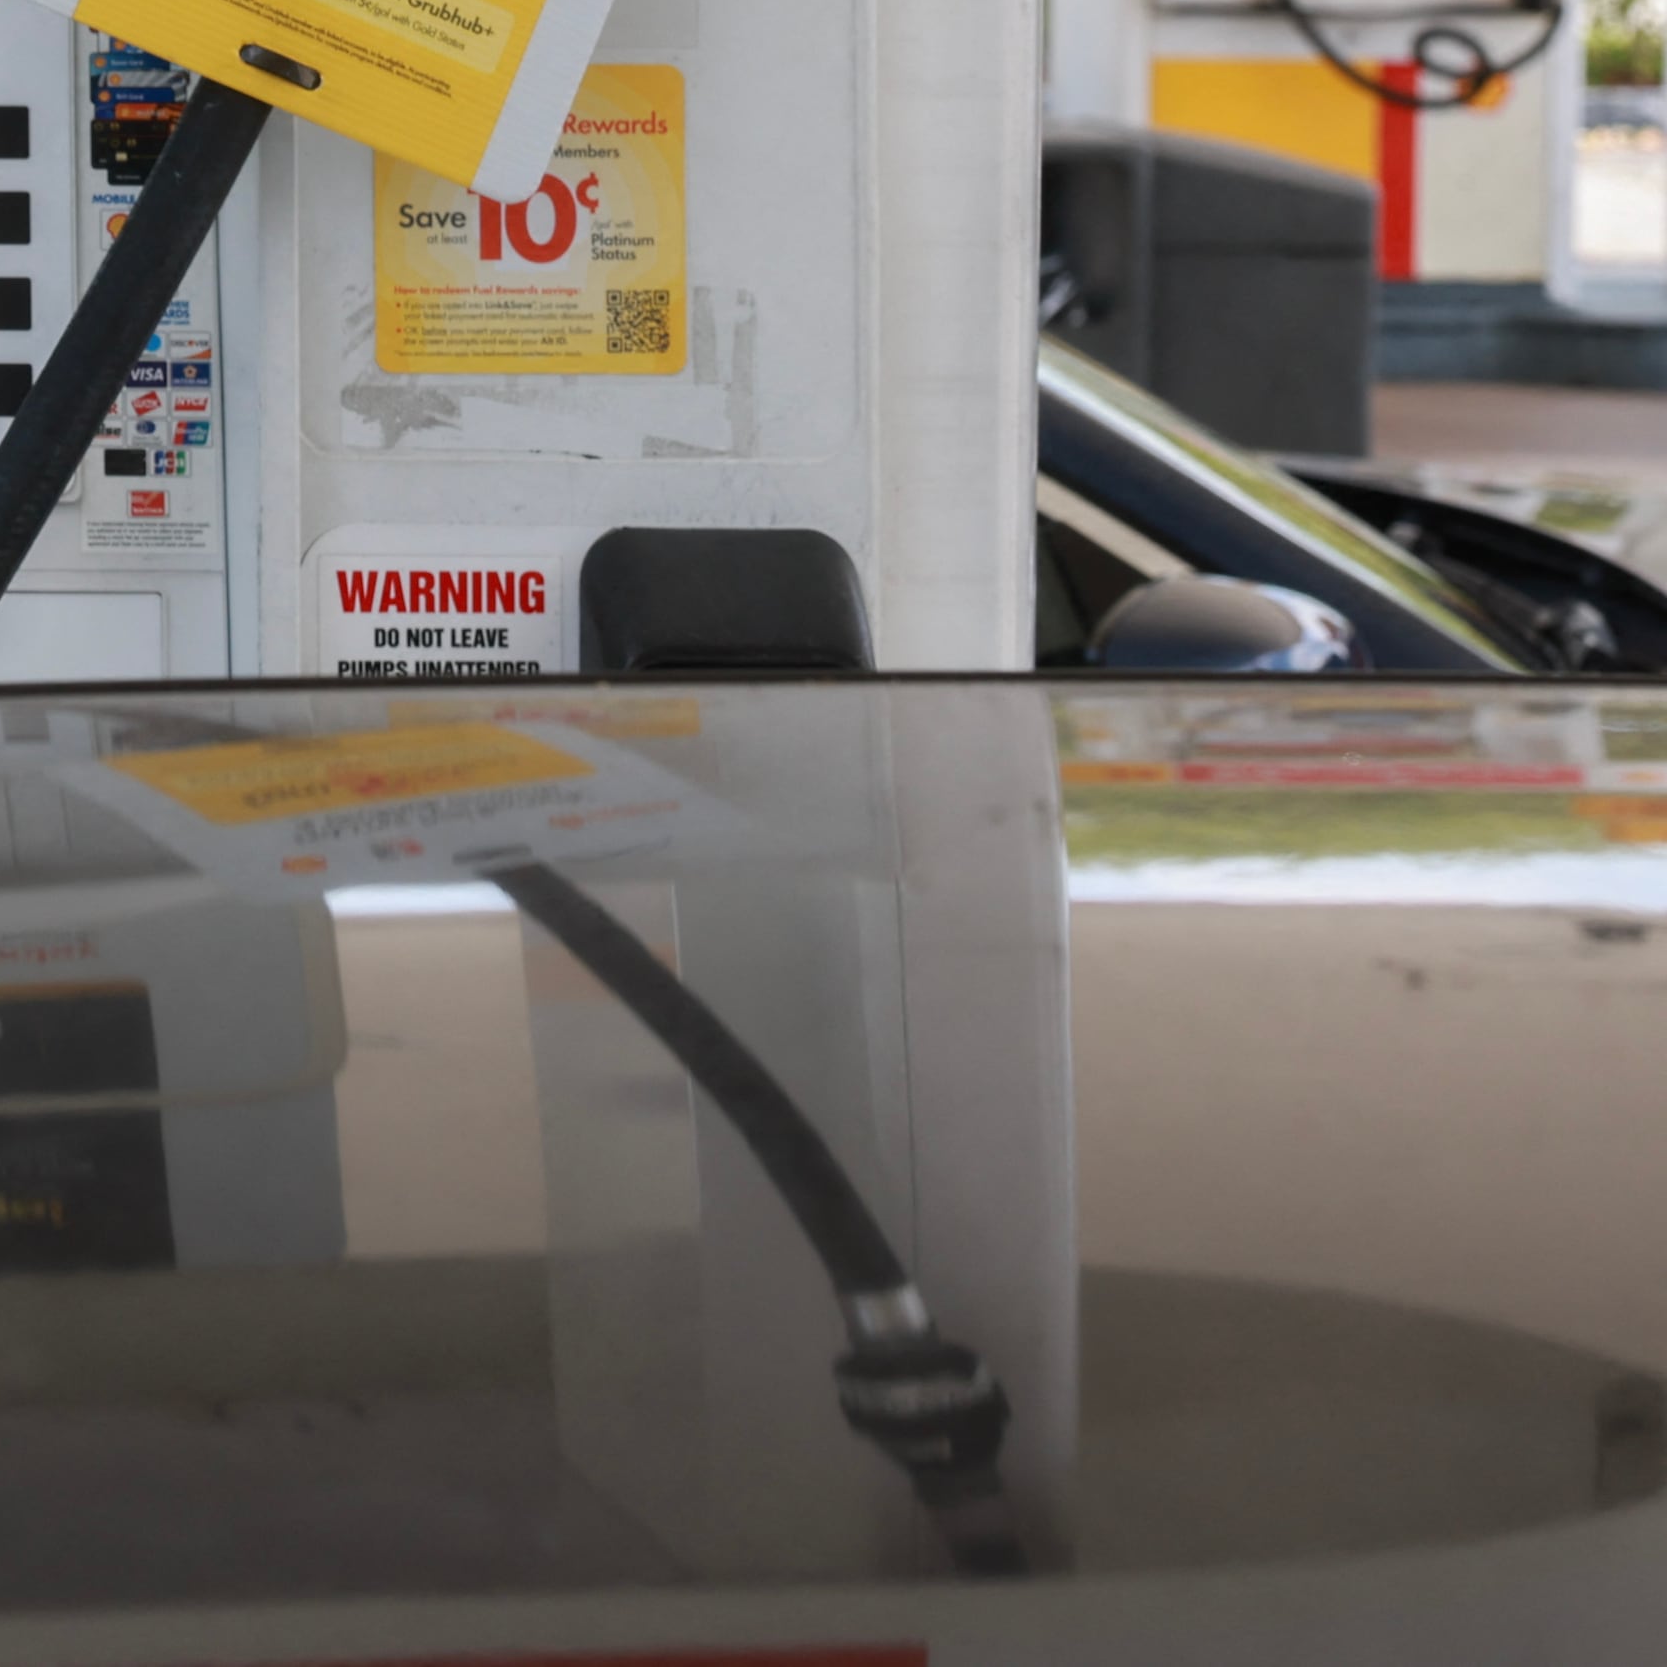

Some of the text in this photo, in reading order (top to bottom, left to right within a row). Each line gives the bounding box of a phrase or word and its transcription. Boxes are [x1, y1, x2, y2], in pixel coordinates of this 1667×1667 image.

[562, 110, 668, 135] Rewards
[398, 203, 467, 229] Save
[426, 233, 468, 245] at least
[591, 232, 655, 247] Platinum
[591, 247, 637, 261] Status
[130, 367, 165, 382] VISA
[336, 569, 546, 615] WARNING
[373, 627, 509, 649] DO NOT LEAVE
[337, 660, 541, 678] PUMPS UNATTENDED
